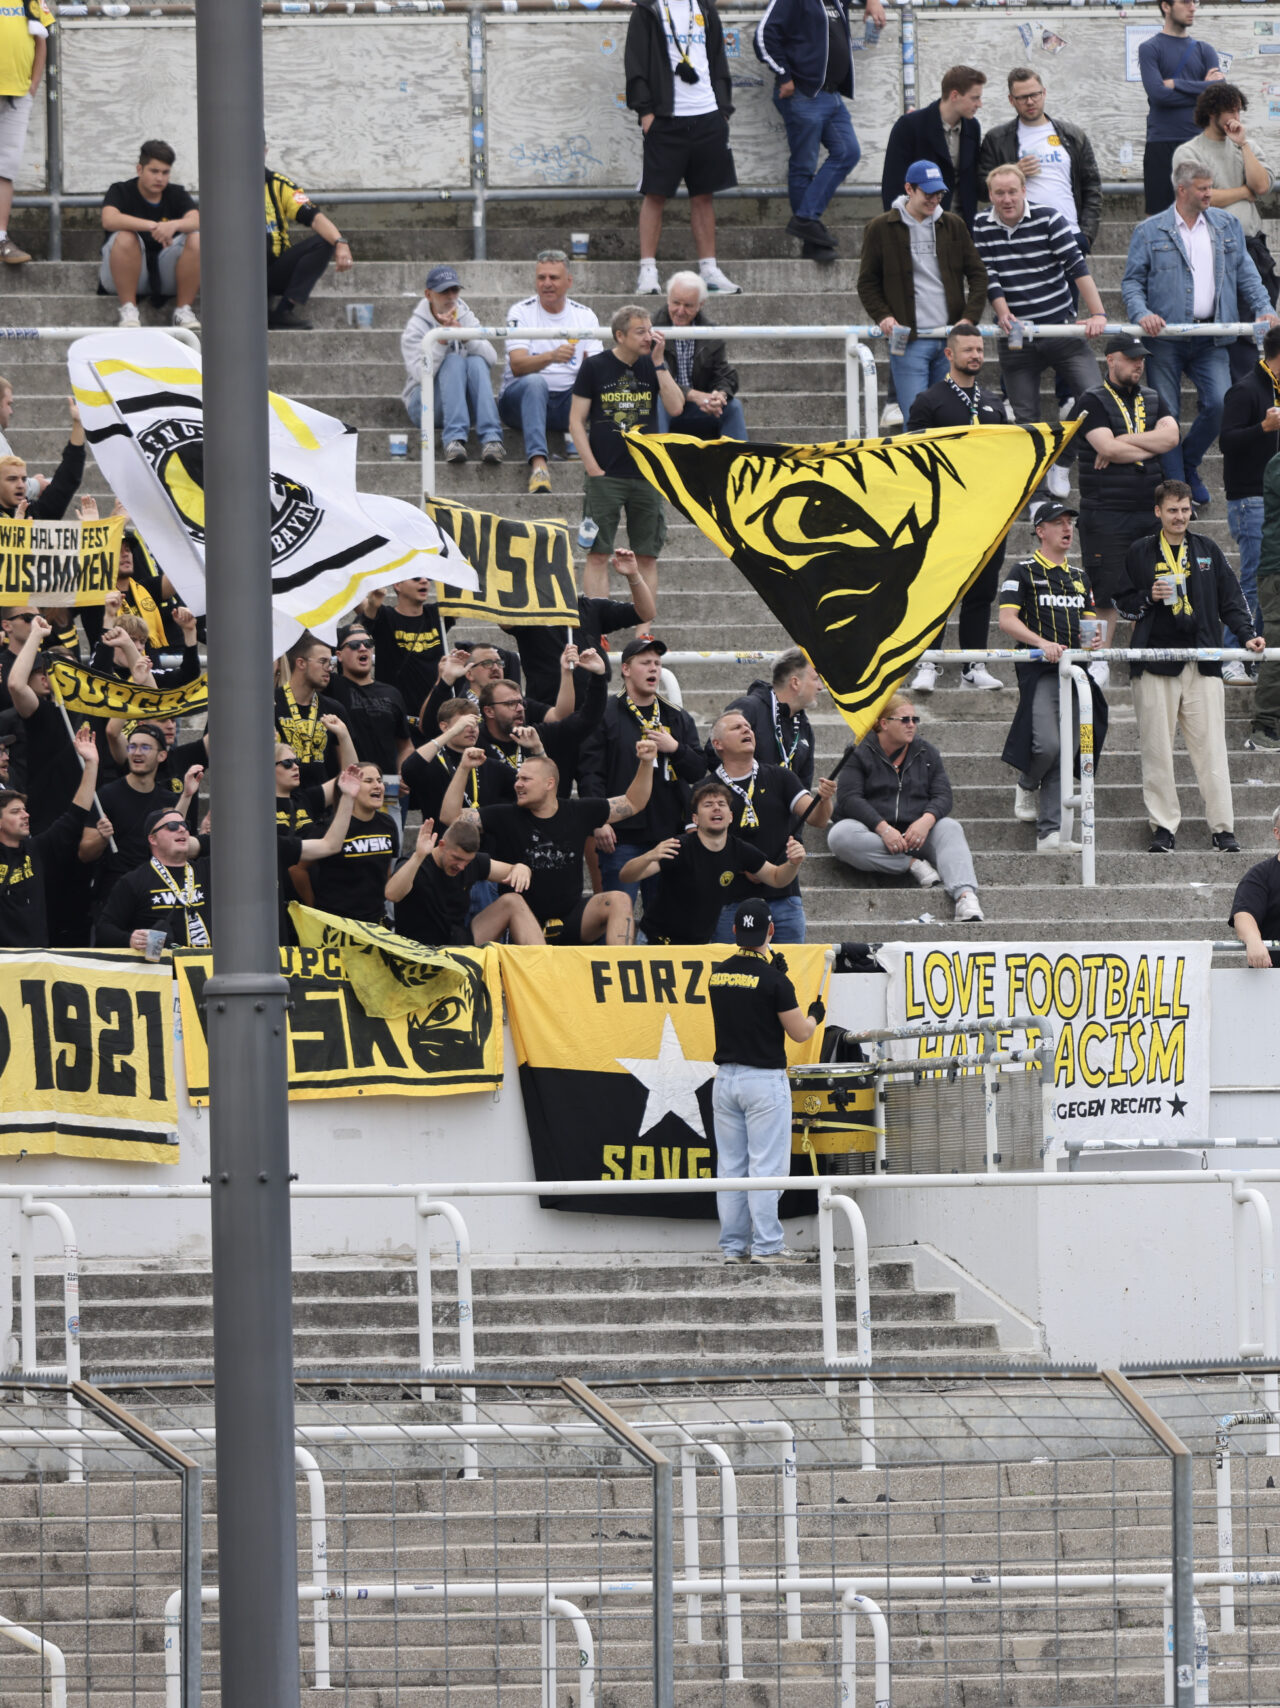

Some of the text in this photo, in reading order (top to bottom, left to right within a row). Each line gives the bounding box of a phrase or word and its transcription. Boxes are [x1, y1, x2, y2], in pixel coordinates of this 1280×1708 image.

[601, 391, 652, 402] NOSTROMO
[30, 527, 78, 550] HALTEN
[82, 526, 110, 549] FEST
[352, 838, 391, 853] WSK
[591, 959, 725, 1004] FORZ
[904, 950, 1190, 1021] LOVE FOOTBALL
[20, 979, 168, 1102] 1921
[1057, 1097, 1161, 1119] GEGEN RECHTS
